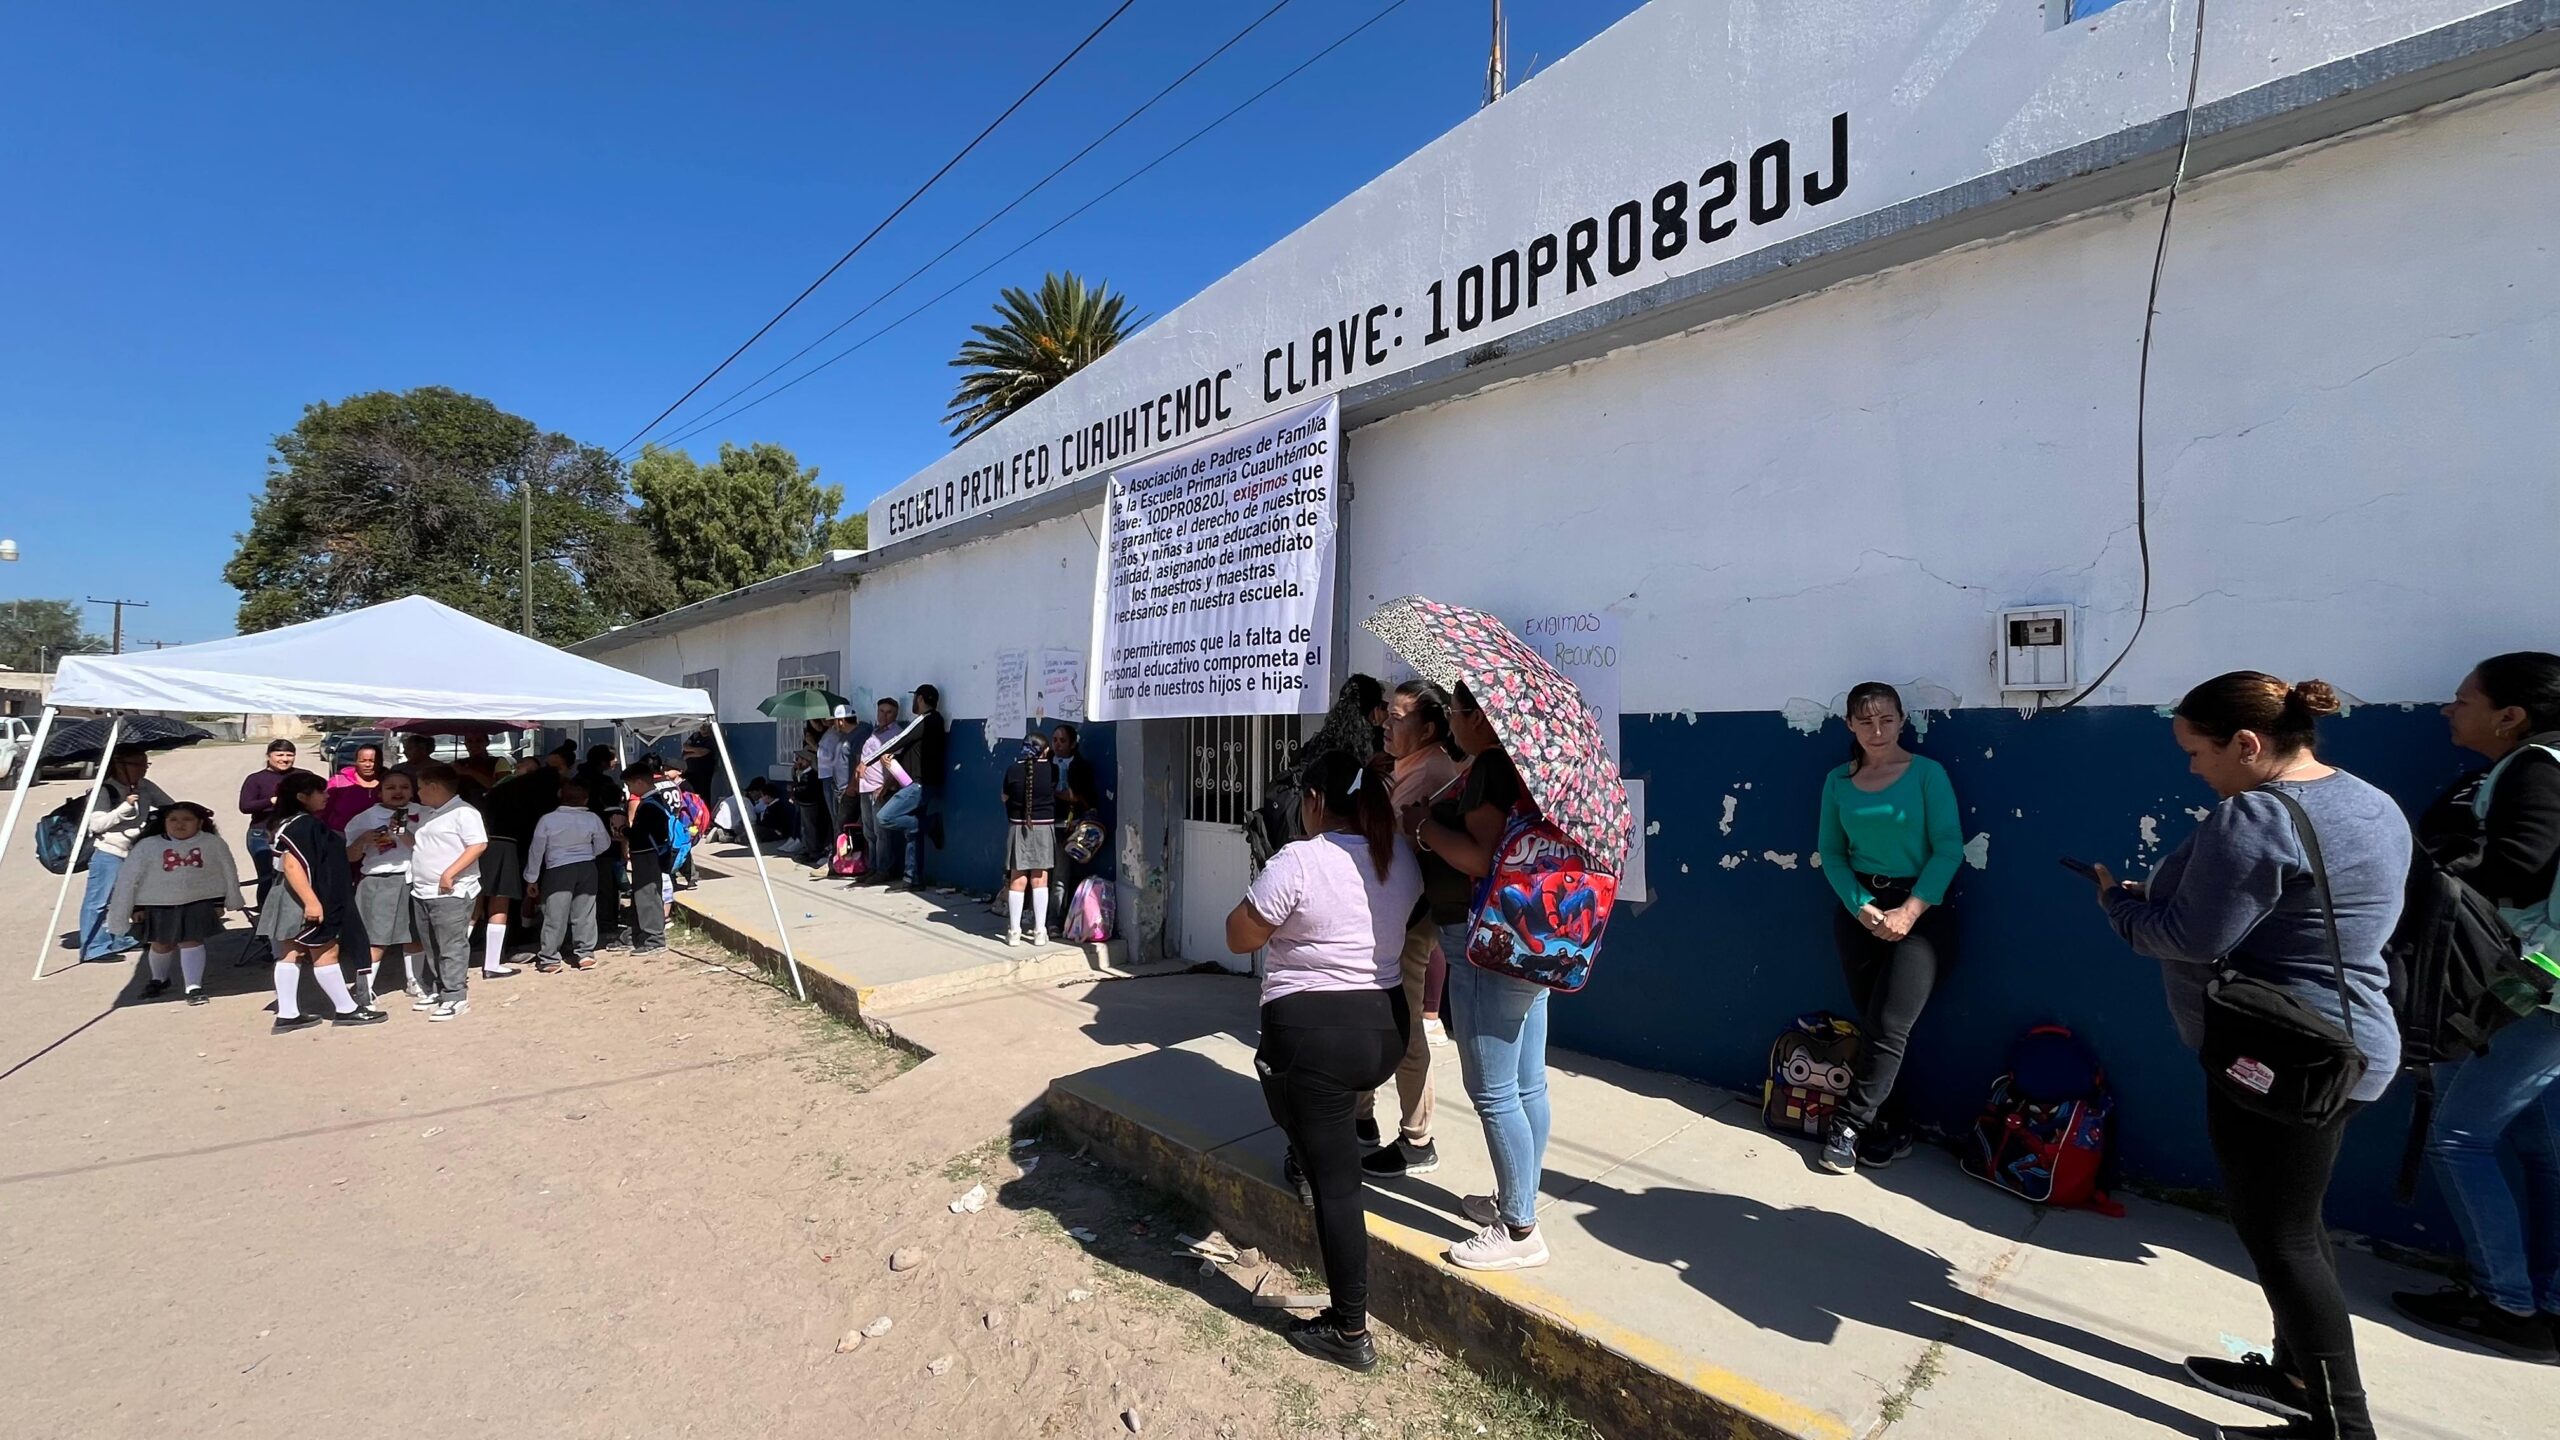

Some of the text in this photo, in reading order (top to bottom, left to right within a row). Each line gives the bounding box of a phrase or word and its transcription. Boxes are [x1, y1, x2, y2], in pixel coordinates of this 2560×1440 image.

[890, 481, 954, 536] ESCUELA
[1264, 303, 1402, 403] CLAVE:
[1424, 111, 1848, 346] 10DPR0820J
[1112, 440, 1327, 516] de la Escuela Primaria Cuauhtémoc
[1113, 416, 1326, 498] La Asociación de Padres de Familia
[1113, 517, 1142, 534] clave:
[1233, 473, 1288, 502] exigimos
[1292, 464, 1323, 487] que
[1121, 528, 1173, 553] garantice
[1176, 519, 1187, 537] el
[1191, 509, 1239, 533] derecho
[1243, 502, 1258, 520] de
[1262, 487, 1326, 514] nuestros
[1114, 508, 1317, 569] niños y niñas a una educación de
[1156, 553, 1216, 580] asignando
[1220, 548, 1234, 566] de
[1239, 533, 1313, 561] inmediato
[1115, 579, 1303, 624] necesarios en nuestra escuela.
[1132, 563, 1275, 602] los maestros y maestras
[1104, 646, 1321, 685] personal educativo comprometa el
[1111, 624, 1310, 664] No permitiremos que la falta de
[1109, 671, 1308, 700] futuro de nuestros hijos e hijas.
